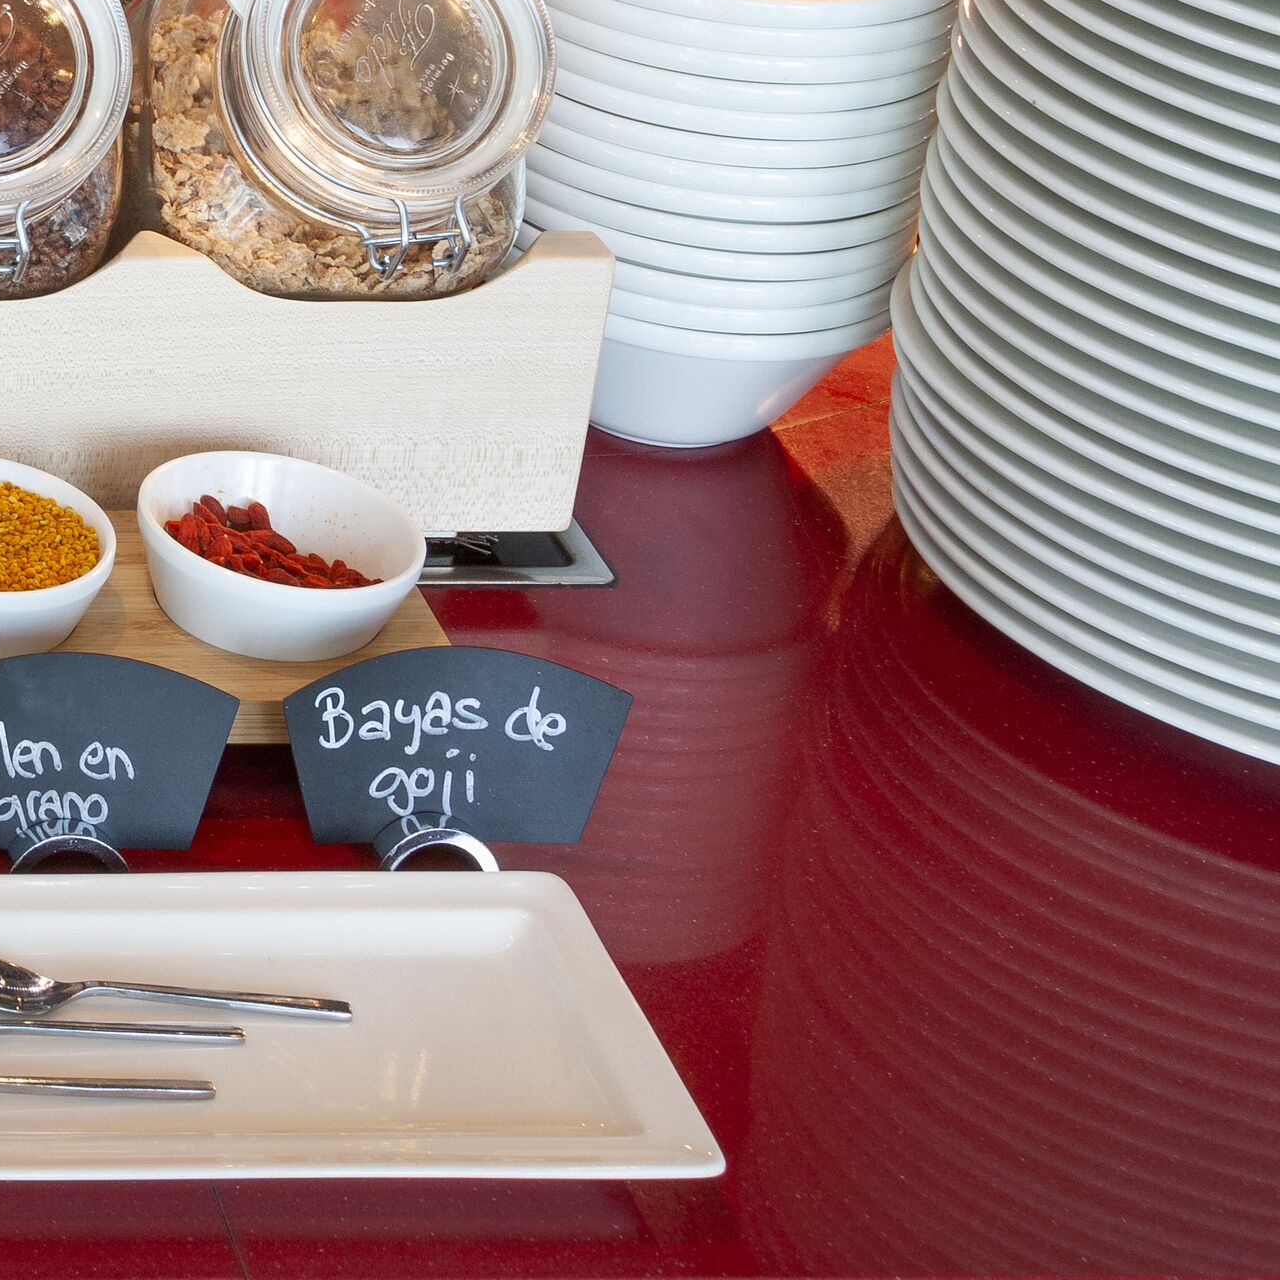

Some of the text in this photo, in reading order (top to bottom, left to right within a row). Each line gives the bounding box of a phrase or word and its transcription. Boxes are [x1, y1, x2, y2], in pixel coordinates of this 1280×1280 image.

[314, 685, 568, 756] Bayas de
[79, 740, 136, 781] en
[368, 748, 477, 817] goji
